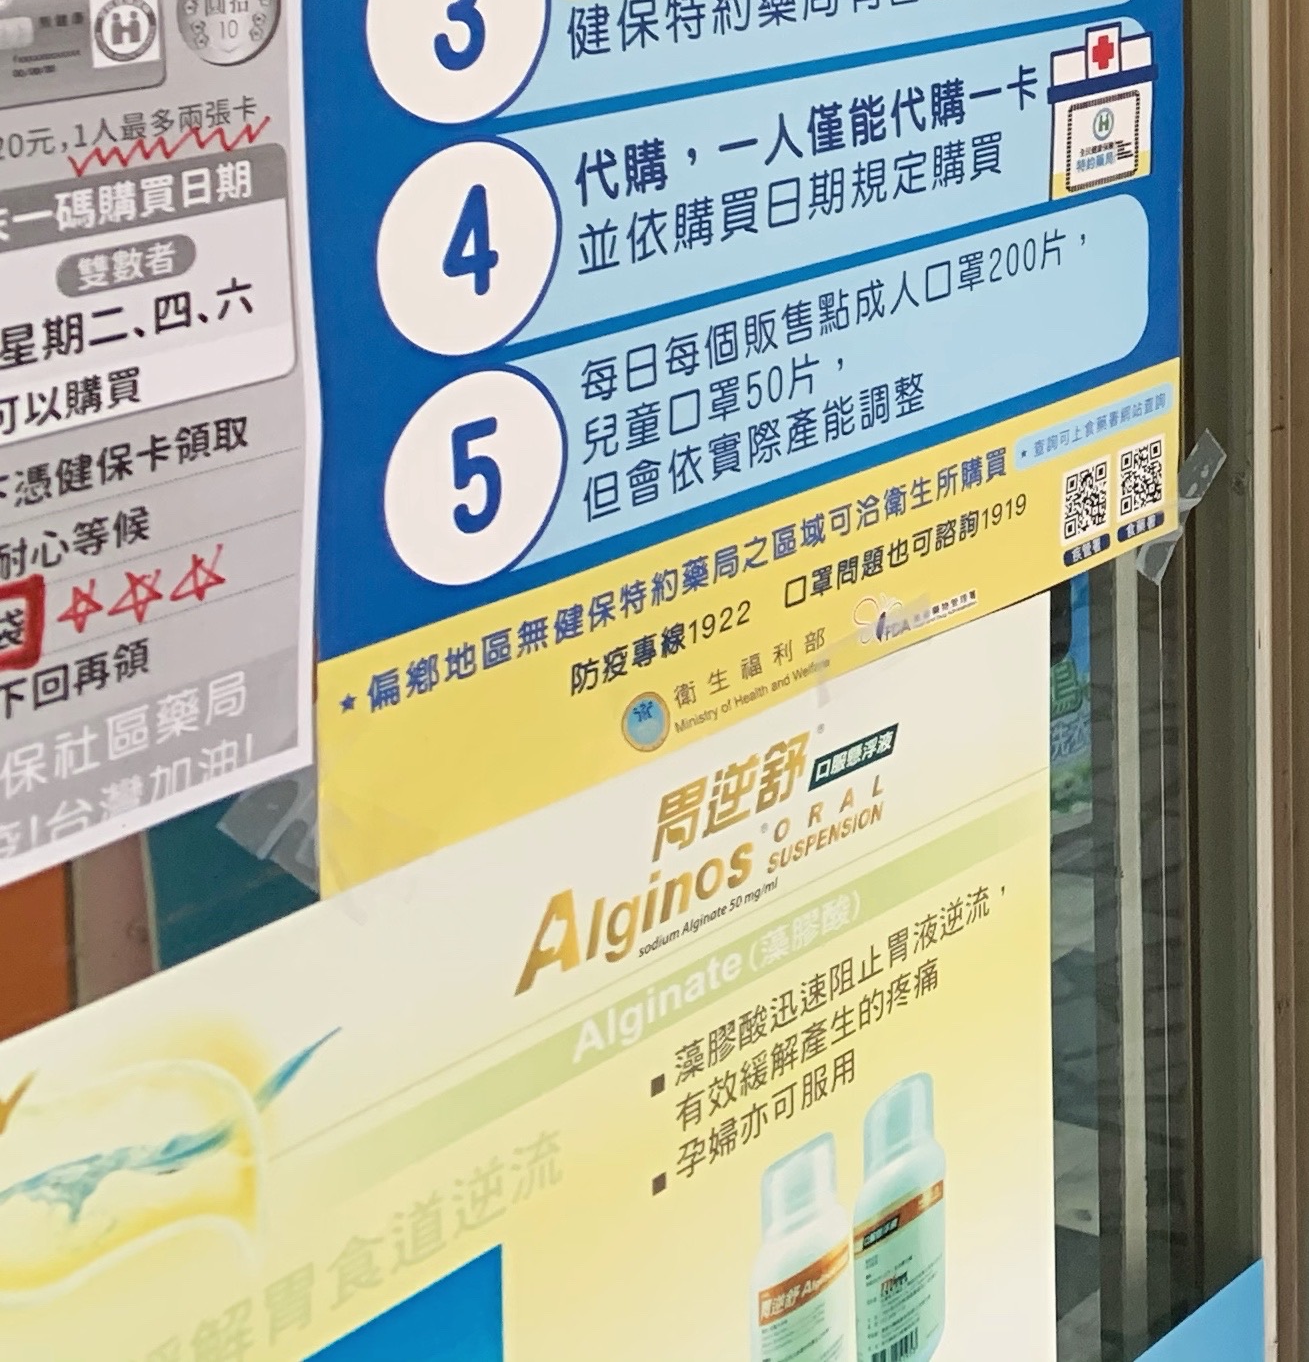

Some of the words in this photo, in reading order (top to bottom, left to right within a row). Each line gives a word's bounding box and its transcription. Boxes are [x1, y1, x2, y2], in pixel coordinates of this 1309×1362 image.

[217, 19, 240, 40] 10
[574, 64, 1038, 208] 代購，一人僅能代購一卡
[443, 183, 499, 296] 4
[577, 130, 1004, 277] 並依購買日期規定購買
[0, 276, 254, 371] 星期二、四、六
[77, 240, 177, 291] 雙數者
[580, 227, 1090, 402] 每日每個販售點成人口罩200片，
[450, 416, 503, 537] 5
[582, 371, 927, 526] 但會依實際產能調整
[364, 445, 1008, 710] 偏鄉地區無健保特約藥局之區域可洽衛生所購買
[570, 600, 751, 697] 防疫專線1922
[783, 492, 1029, 609] 口罩問題也可諮詢1919
[0, 637, 151, 720] 下回再領
[673, 625, 827, 710] 衛生福利部
[674, 706, 718, 734] Ministry
[720, 698, 733, 713] of
[734, 682, 770, 707] Health
[771, 675, 791, 693] and
[2, 669, 248, 801] 保社區藥局
[813, 733, 895, 784] 口服懸浮液
[765, 800, 884, 875] SUSPENSION
[514, 839, 755, 998] Alginos
[637, 928, 681, 958] sodium
[681, 903, 728, 938] Alginate
[728, 894, 743, 913] 50
[743, 877, 780, 907] mg/ml
[571, 949, 744, 1063] Alginate
[674, 884, 1008, 1088] 藻膠酸迅速阻止胃液逆流，
[675, 957, 940, 1133] 有效緩解產生的疼痛
[675, 1048, 858, 1180] 孕婦亦可服用
